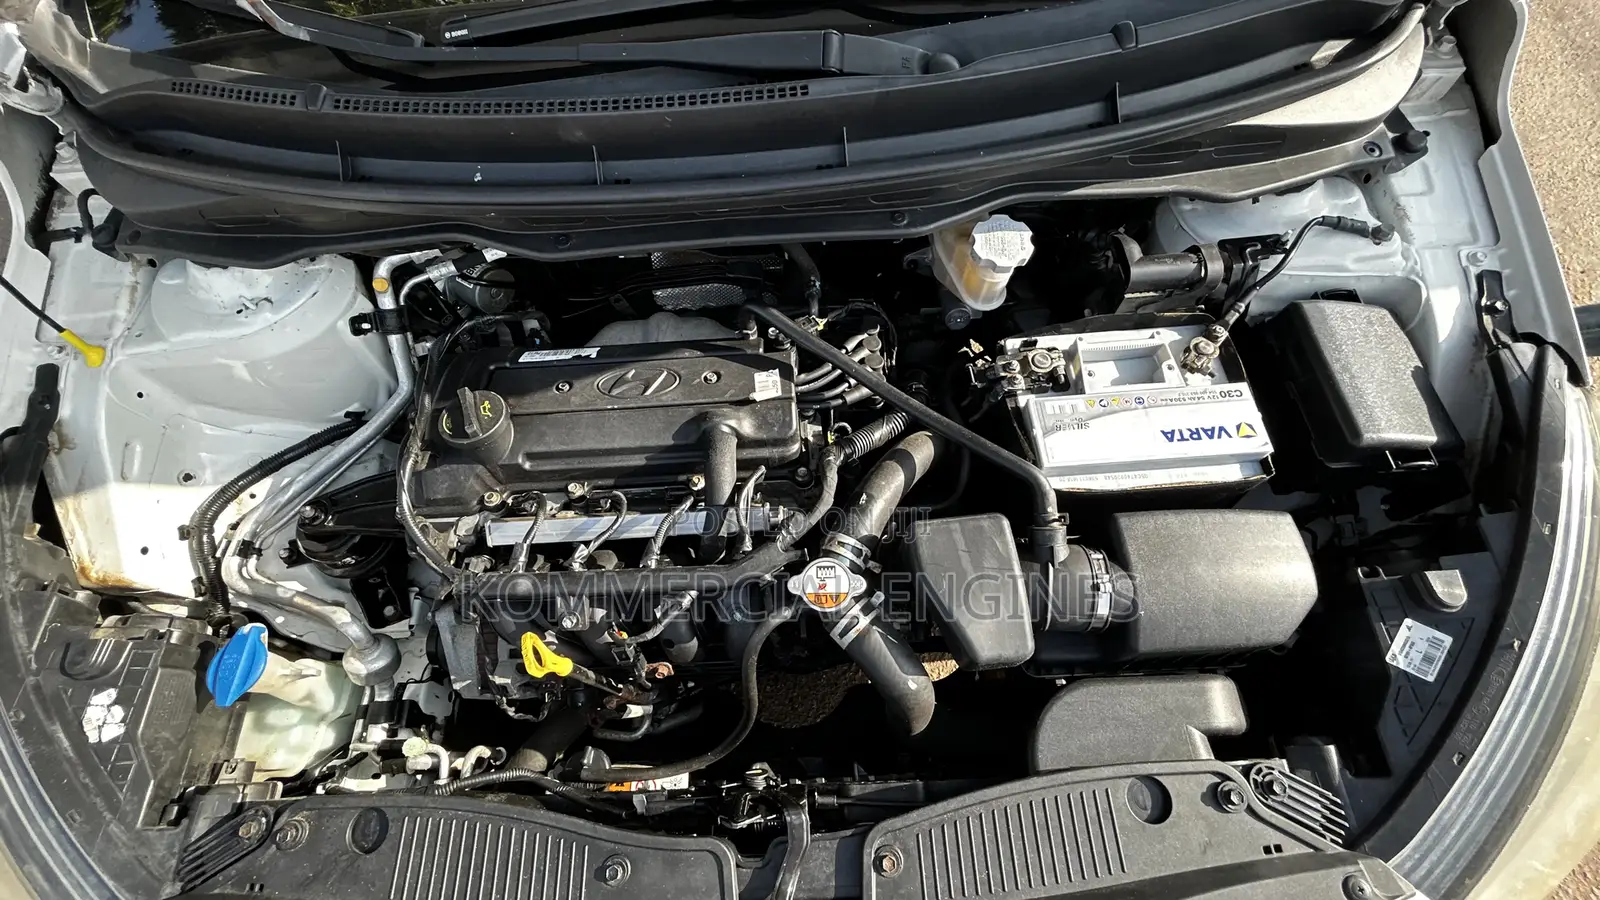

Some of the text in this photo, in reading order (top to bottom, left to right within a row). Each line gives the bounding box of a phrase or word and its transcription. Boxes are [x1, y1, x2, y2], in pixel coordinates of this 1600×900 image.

[1219, 389, 1243, 399] C30
[1055, 422, 1090, 431] SILVER
[1160, 426, 1233, 443] VARTA
